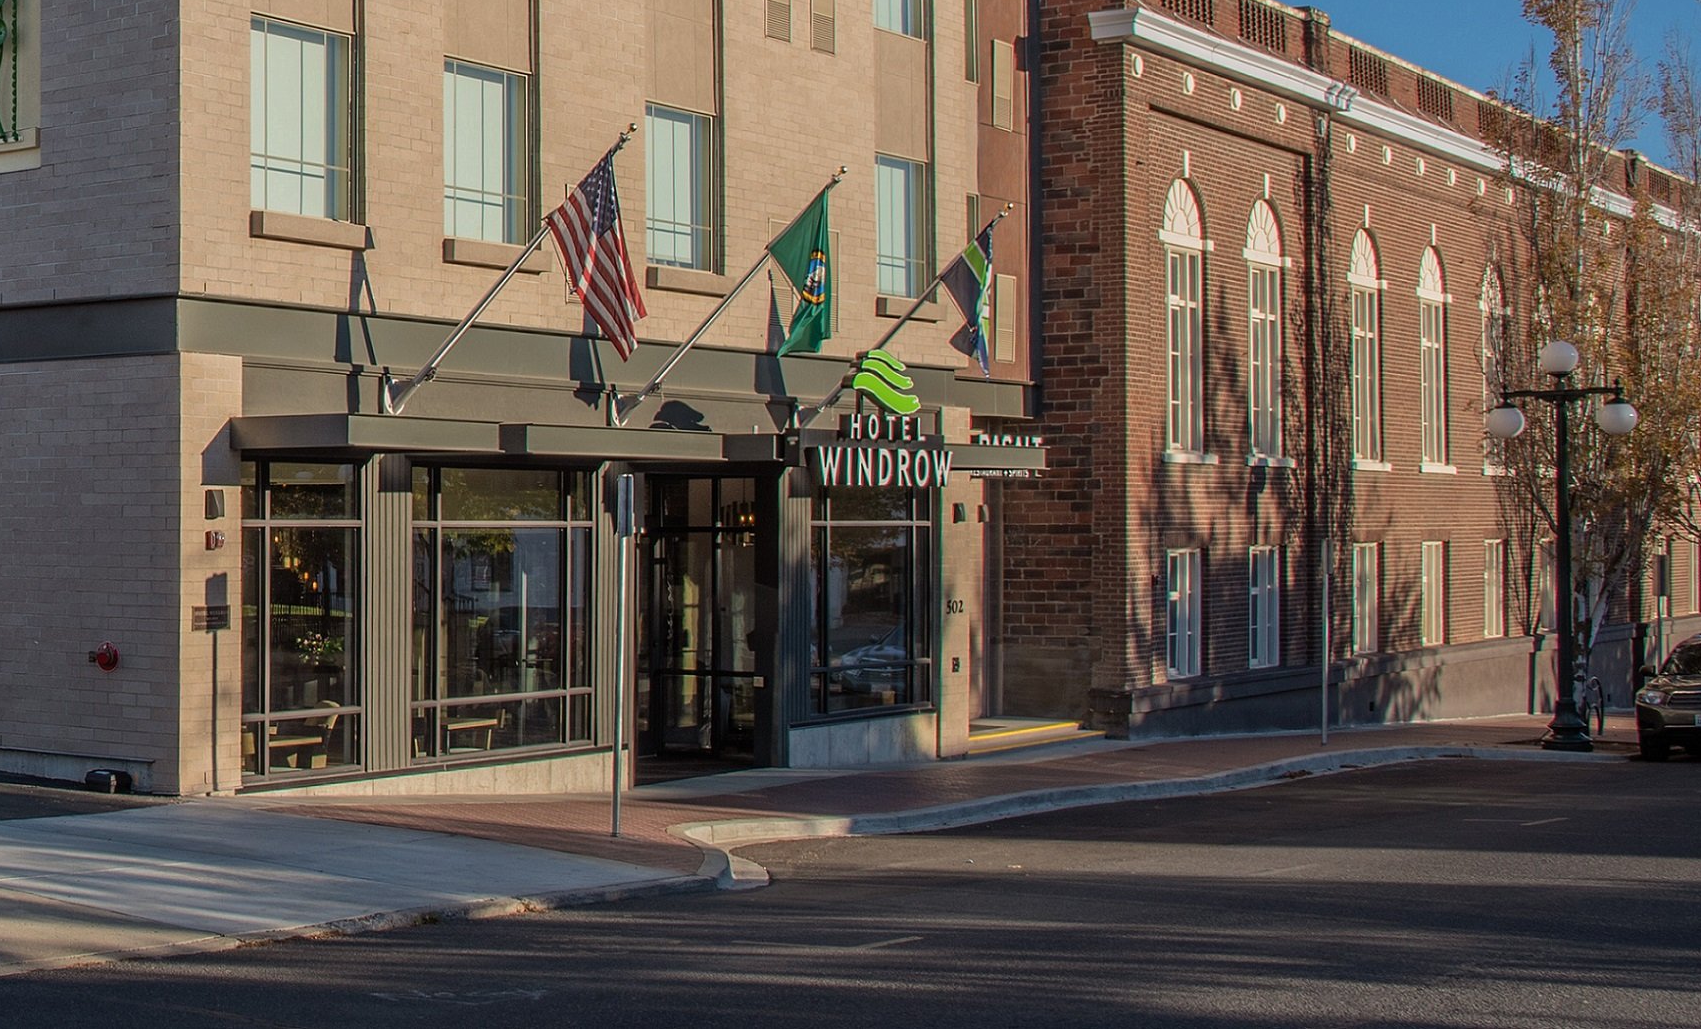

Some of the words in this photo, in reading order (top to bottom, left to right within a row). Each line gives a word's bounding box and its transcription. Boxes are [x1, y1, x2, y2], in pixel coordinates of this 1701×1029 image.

[849, 413, 927, 442] HOTEL
[817, 445, 954, 488] WINDROW
[945, 599, 964, 615] 502
